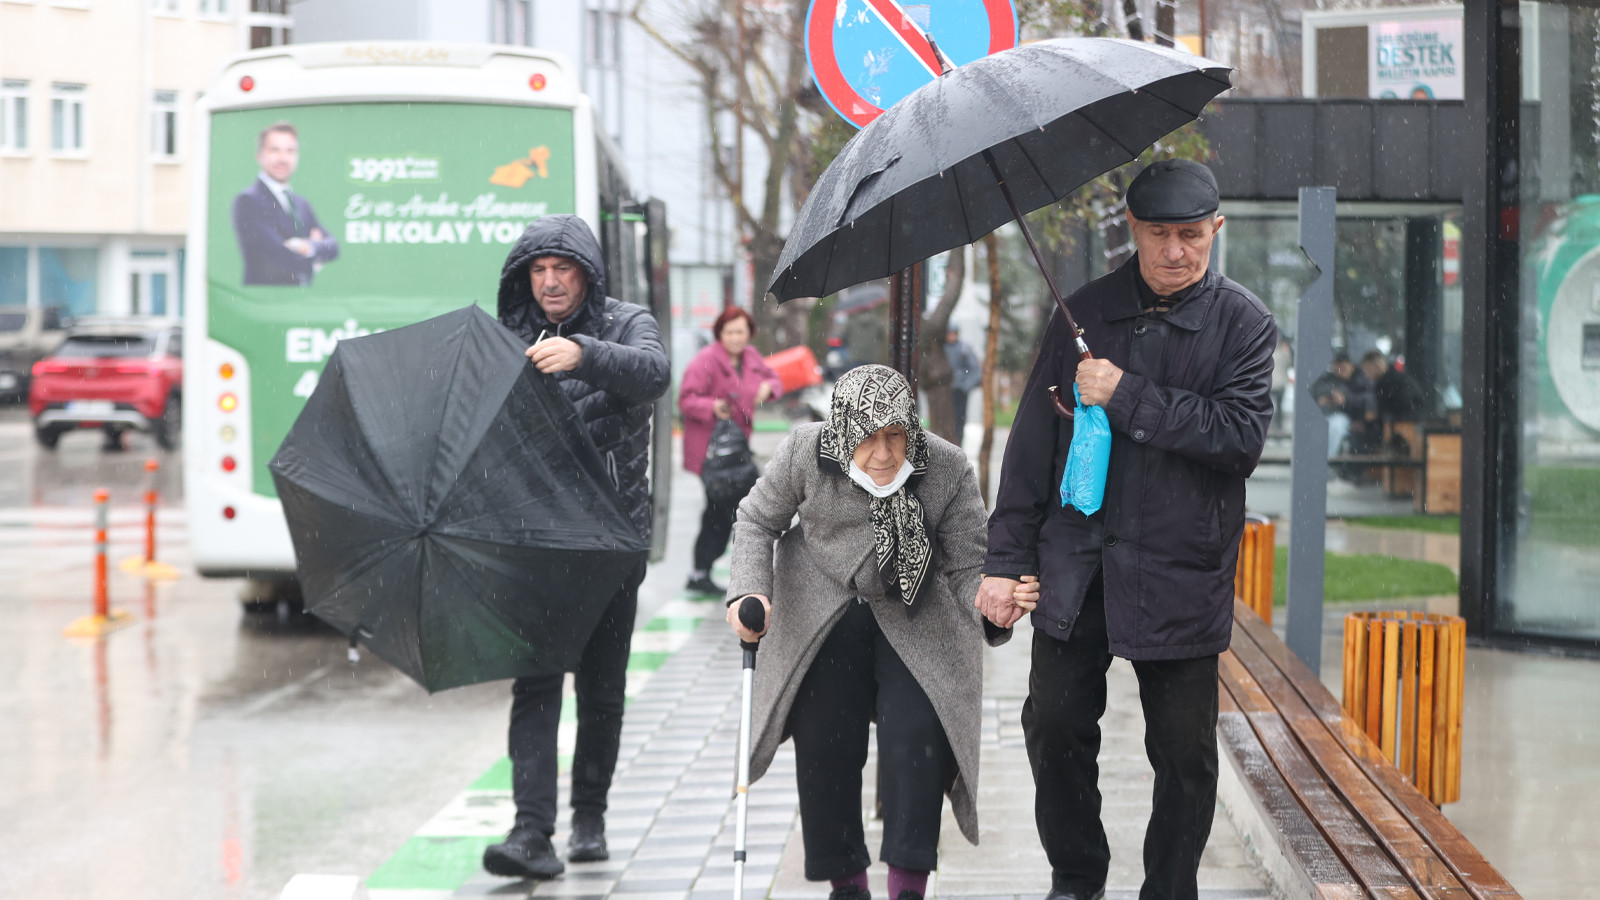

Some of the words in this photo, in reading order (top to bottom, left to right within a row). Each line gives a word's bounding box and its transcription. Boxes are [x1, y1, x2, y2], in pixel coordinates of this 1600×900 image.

[1377, 43, 1454, 67] DESTEK
[397, 192, 460, 218] Araba
[345, 221, 381, 244] EN
[384, 221, 474, 244] KOLAY
[477, 221, 532, 244] YOL
